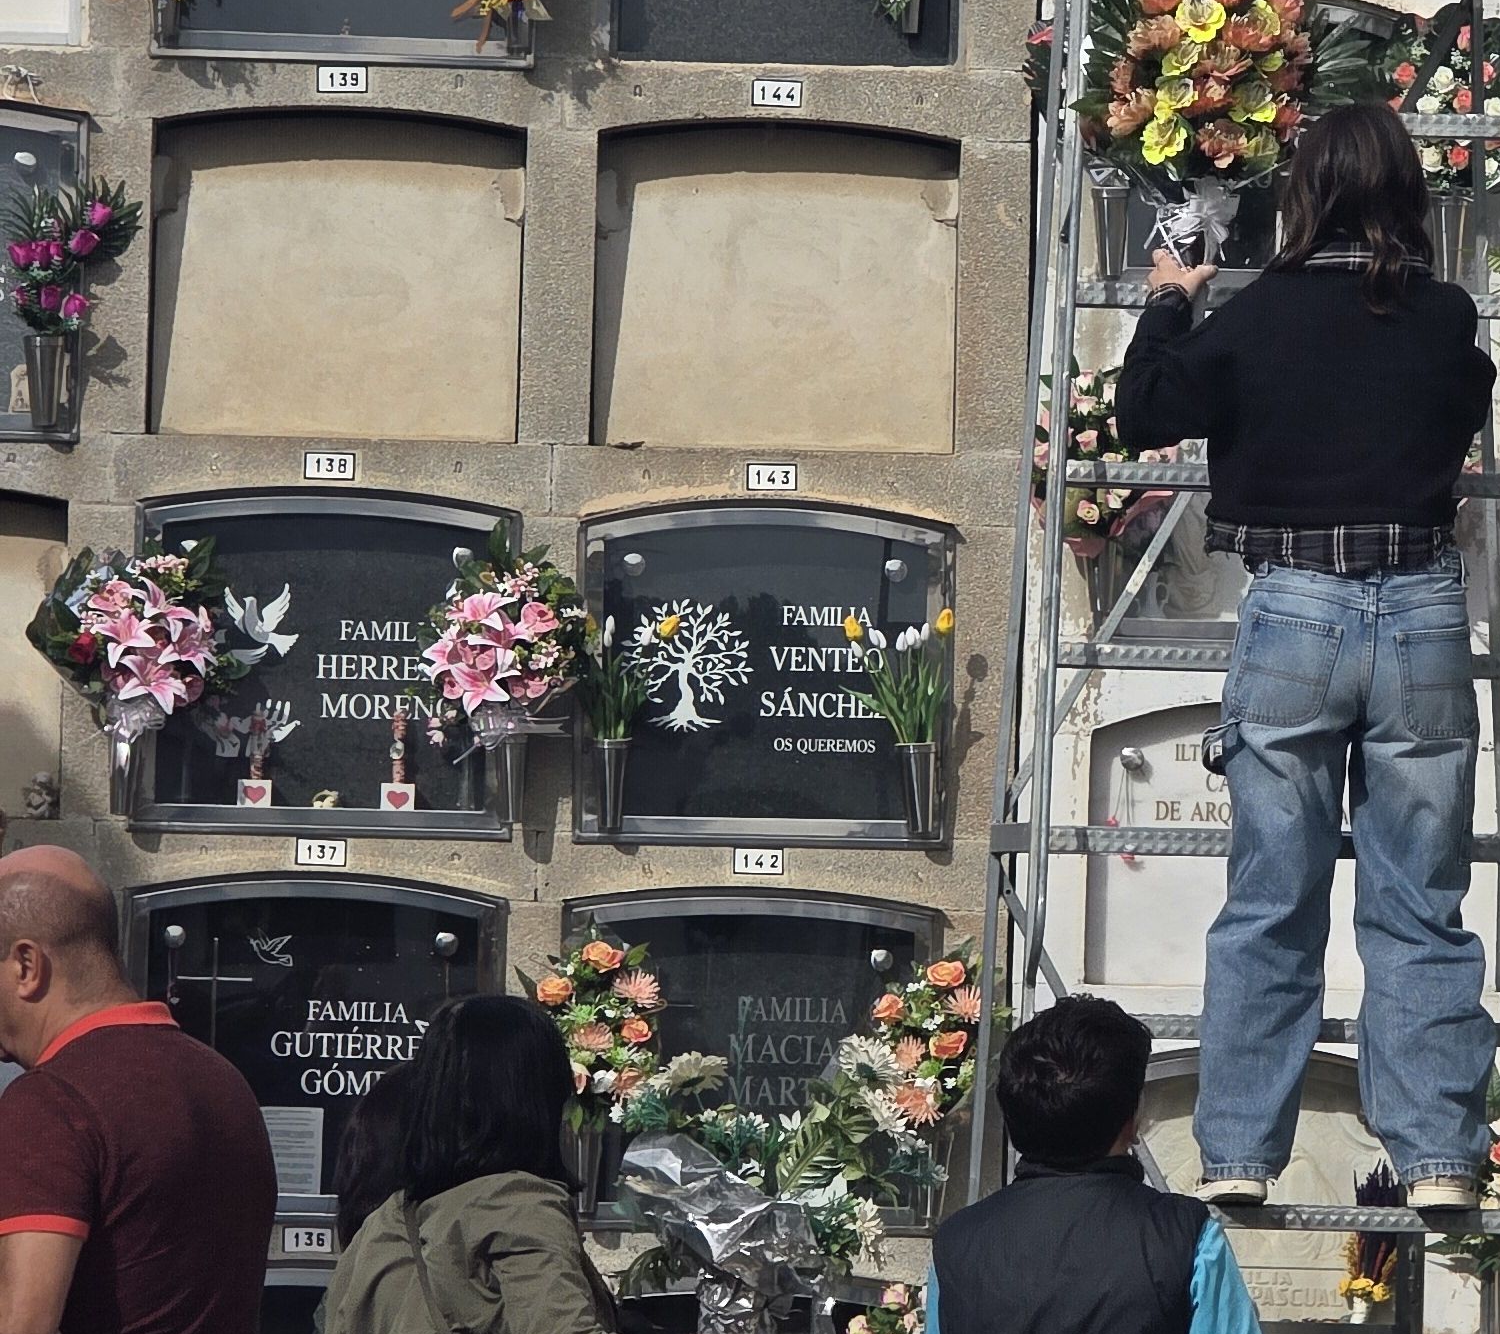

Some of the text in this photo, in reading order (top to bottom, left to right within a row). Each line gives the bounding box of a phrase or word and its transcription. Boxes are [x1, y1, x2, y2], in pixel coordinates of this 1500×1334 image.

[328, 72, 360, 88] 139
[759, 86, 796, 102] 144
[314, 457, 348, 474] 138
[754, 470, 791, 486] 143
[339, 619, 424, 642] FAMIL
[316, 653, 430, 681] HERRE
[769, 646, 884, 674] VENTEO
[773, 737, 876, 754] OS QUEREMOS
[1155, 800, 1232, 827] DE ARQ
[305, 844, 338, 861] 137
[742, 853, 780, 869] 142
[307, 1000, 410, 1024] FAMILIA
[737, 995, 848, 1024] FAMILIA
[270, 1026, 423, 1061] GUTIÉRRE
[728, 1032, 835, 1065] MACIA
[300, 1063, 386, 1097] GÓM
[293, 1231, 326, 1247] 136
